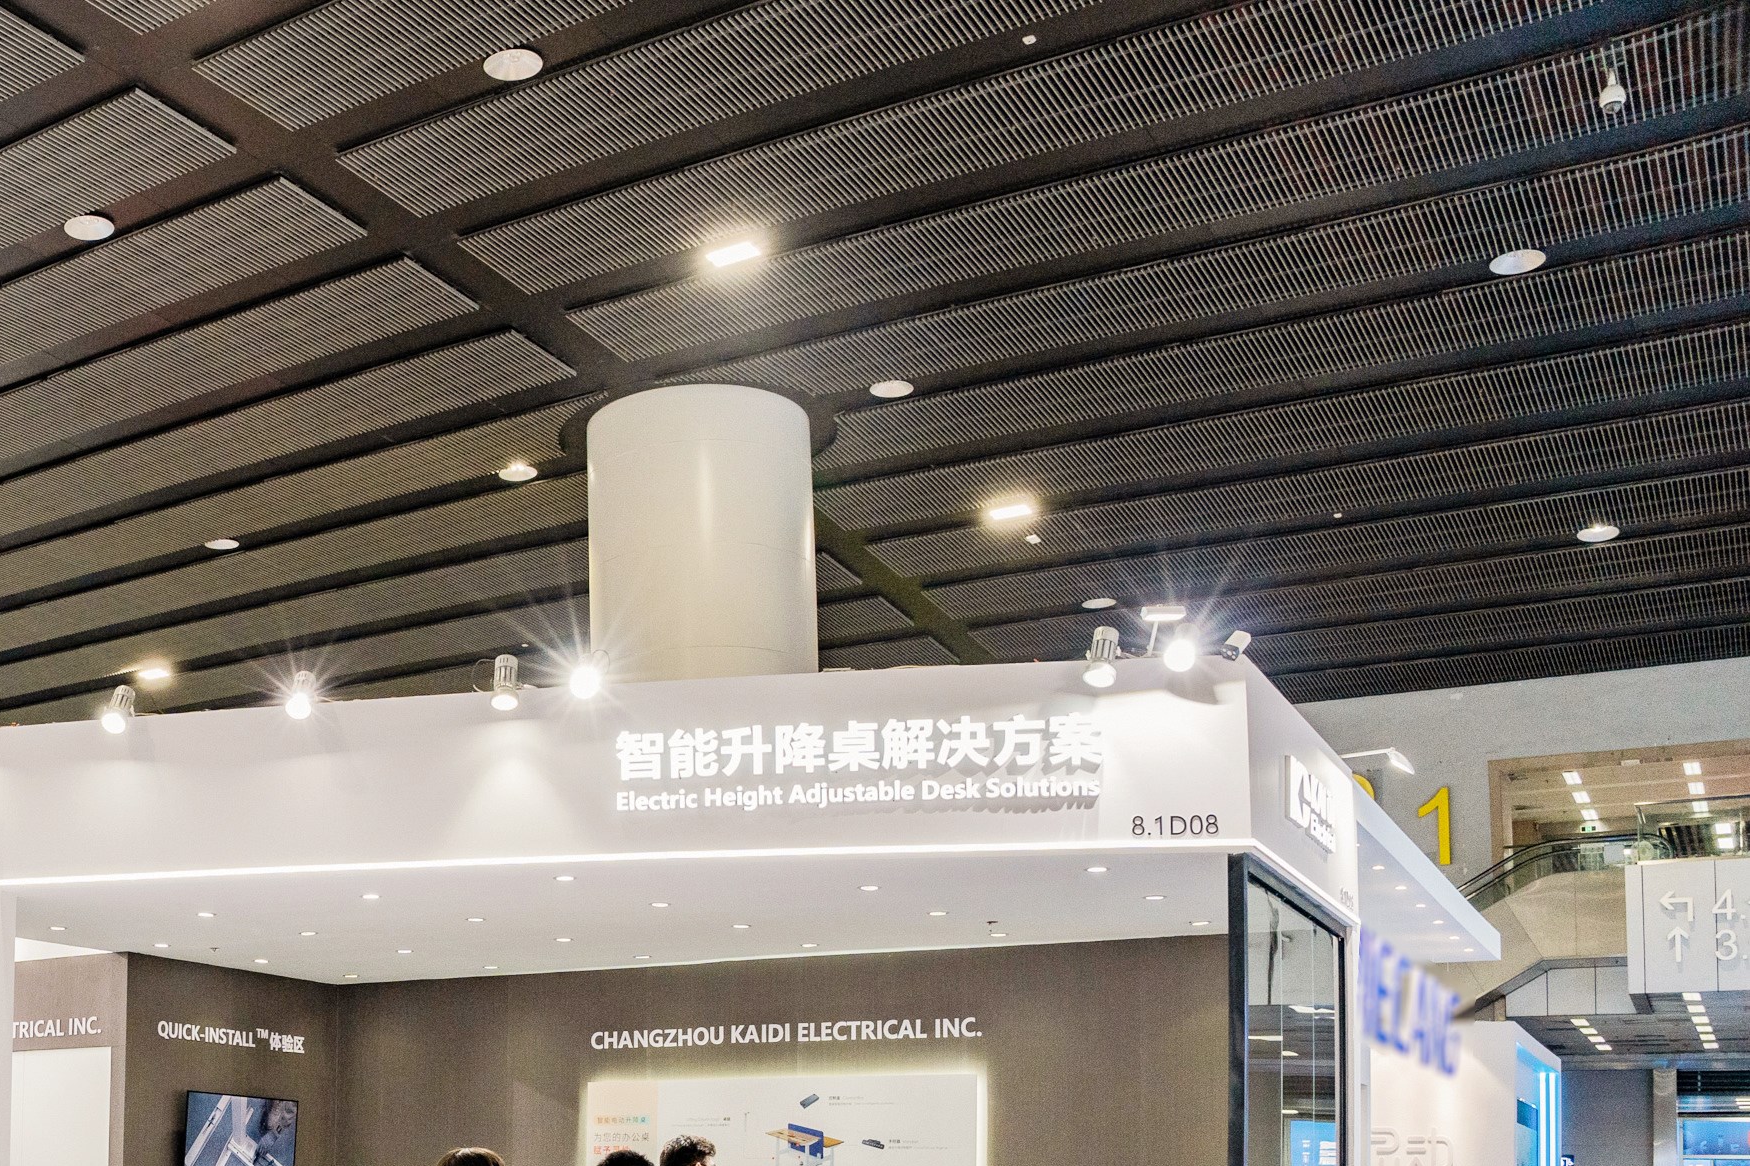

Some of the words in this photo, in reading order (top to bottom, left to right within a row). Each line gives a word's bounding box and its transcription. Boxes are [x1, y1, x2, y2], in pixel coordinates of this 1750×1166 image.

[615, 712, 1102, 781] 智能升降桌解决方案
[616, 788, 698, 811] Electric
[704, 784, 783, 811] Height
[788, 780, 915, 809] Adjustable
[921, 777, 982, 801] Desk
[986, 776, 1100, 798] Solutions
[1132, 814, 1219, 836] 8.1D08
[68, 1016, 102, 1036] INC.
[590, 1025, 725, 1050] CHANGZHOU
[730, 1022, 791, 1044] KAIDI
[797, 1019, 928, 1042] ELECTRICAL
[934, 1016, 983, 1039] INC.
[593, 1132, 650, 1142] 为您的办公桌
